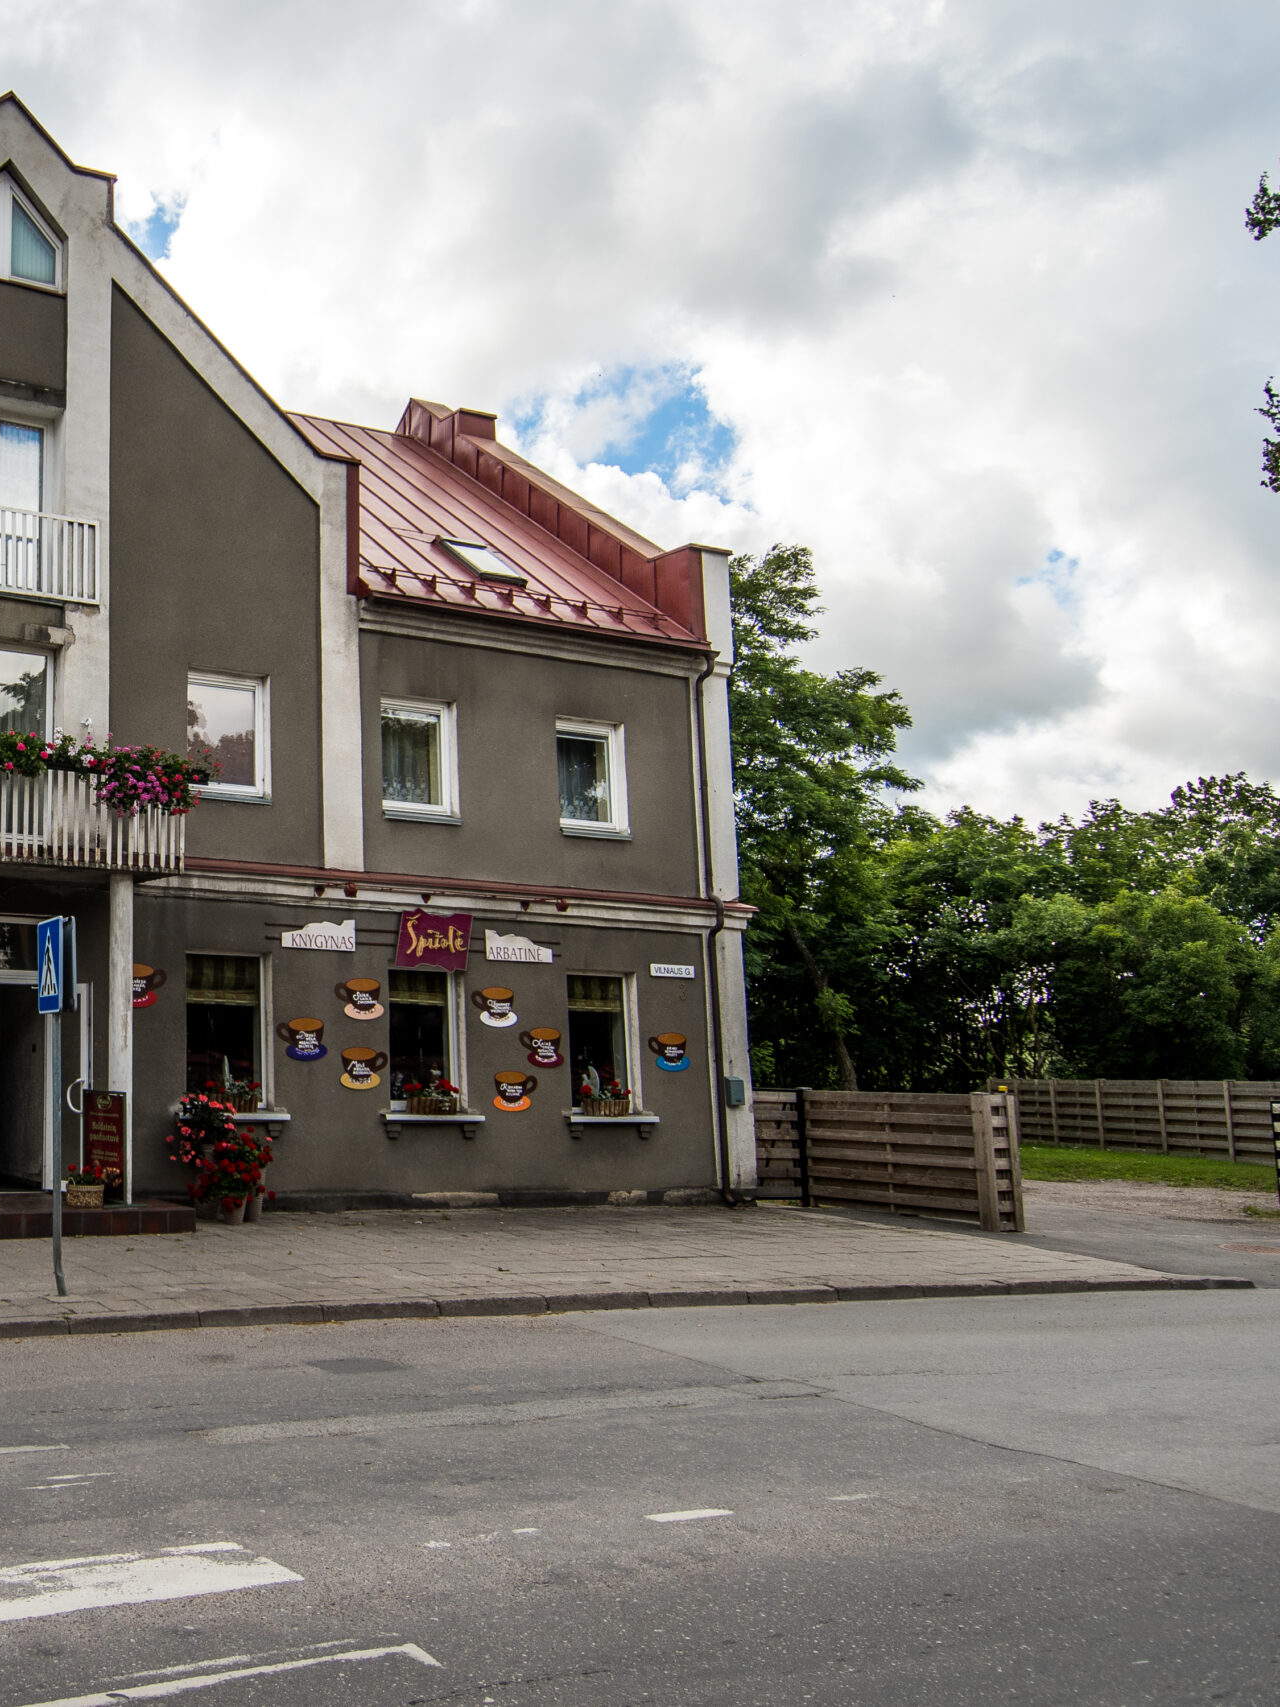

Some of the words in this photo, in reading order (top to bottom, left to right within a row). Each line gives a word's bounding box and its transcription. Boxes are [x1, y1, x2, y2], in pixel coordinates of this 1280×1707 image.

[291, 933, 354, 950] KNYGYNAS
[488, 946, 543, 961] ARBATINĖ
[653, 966, 683, 976] VILNIAUS
